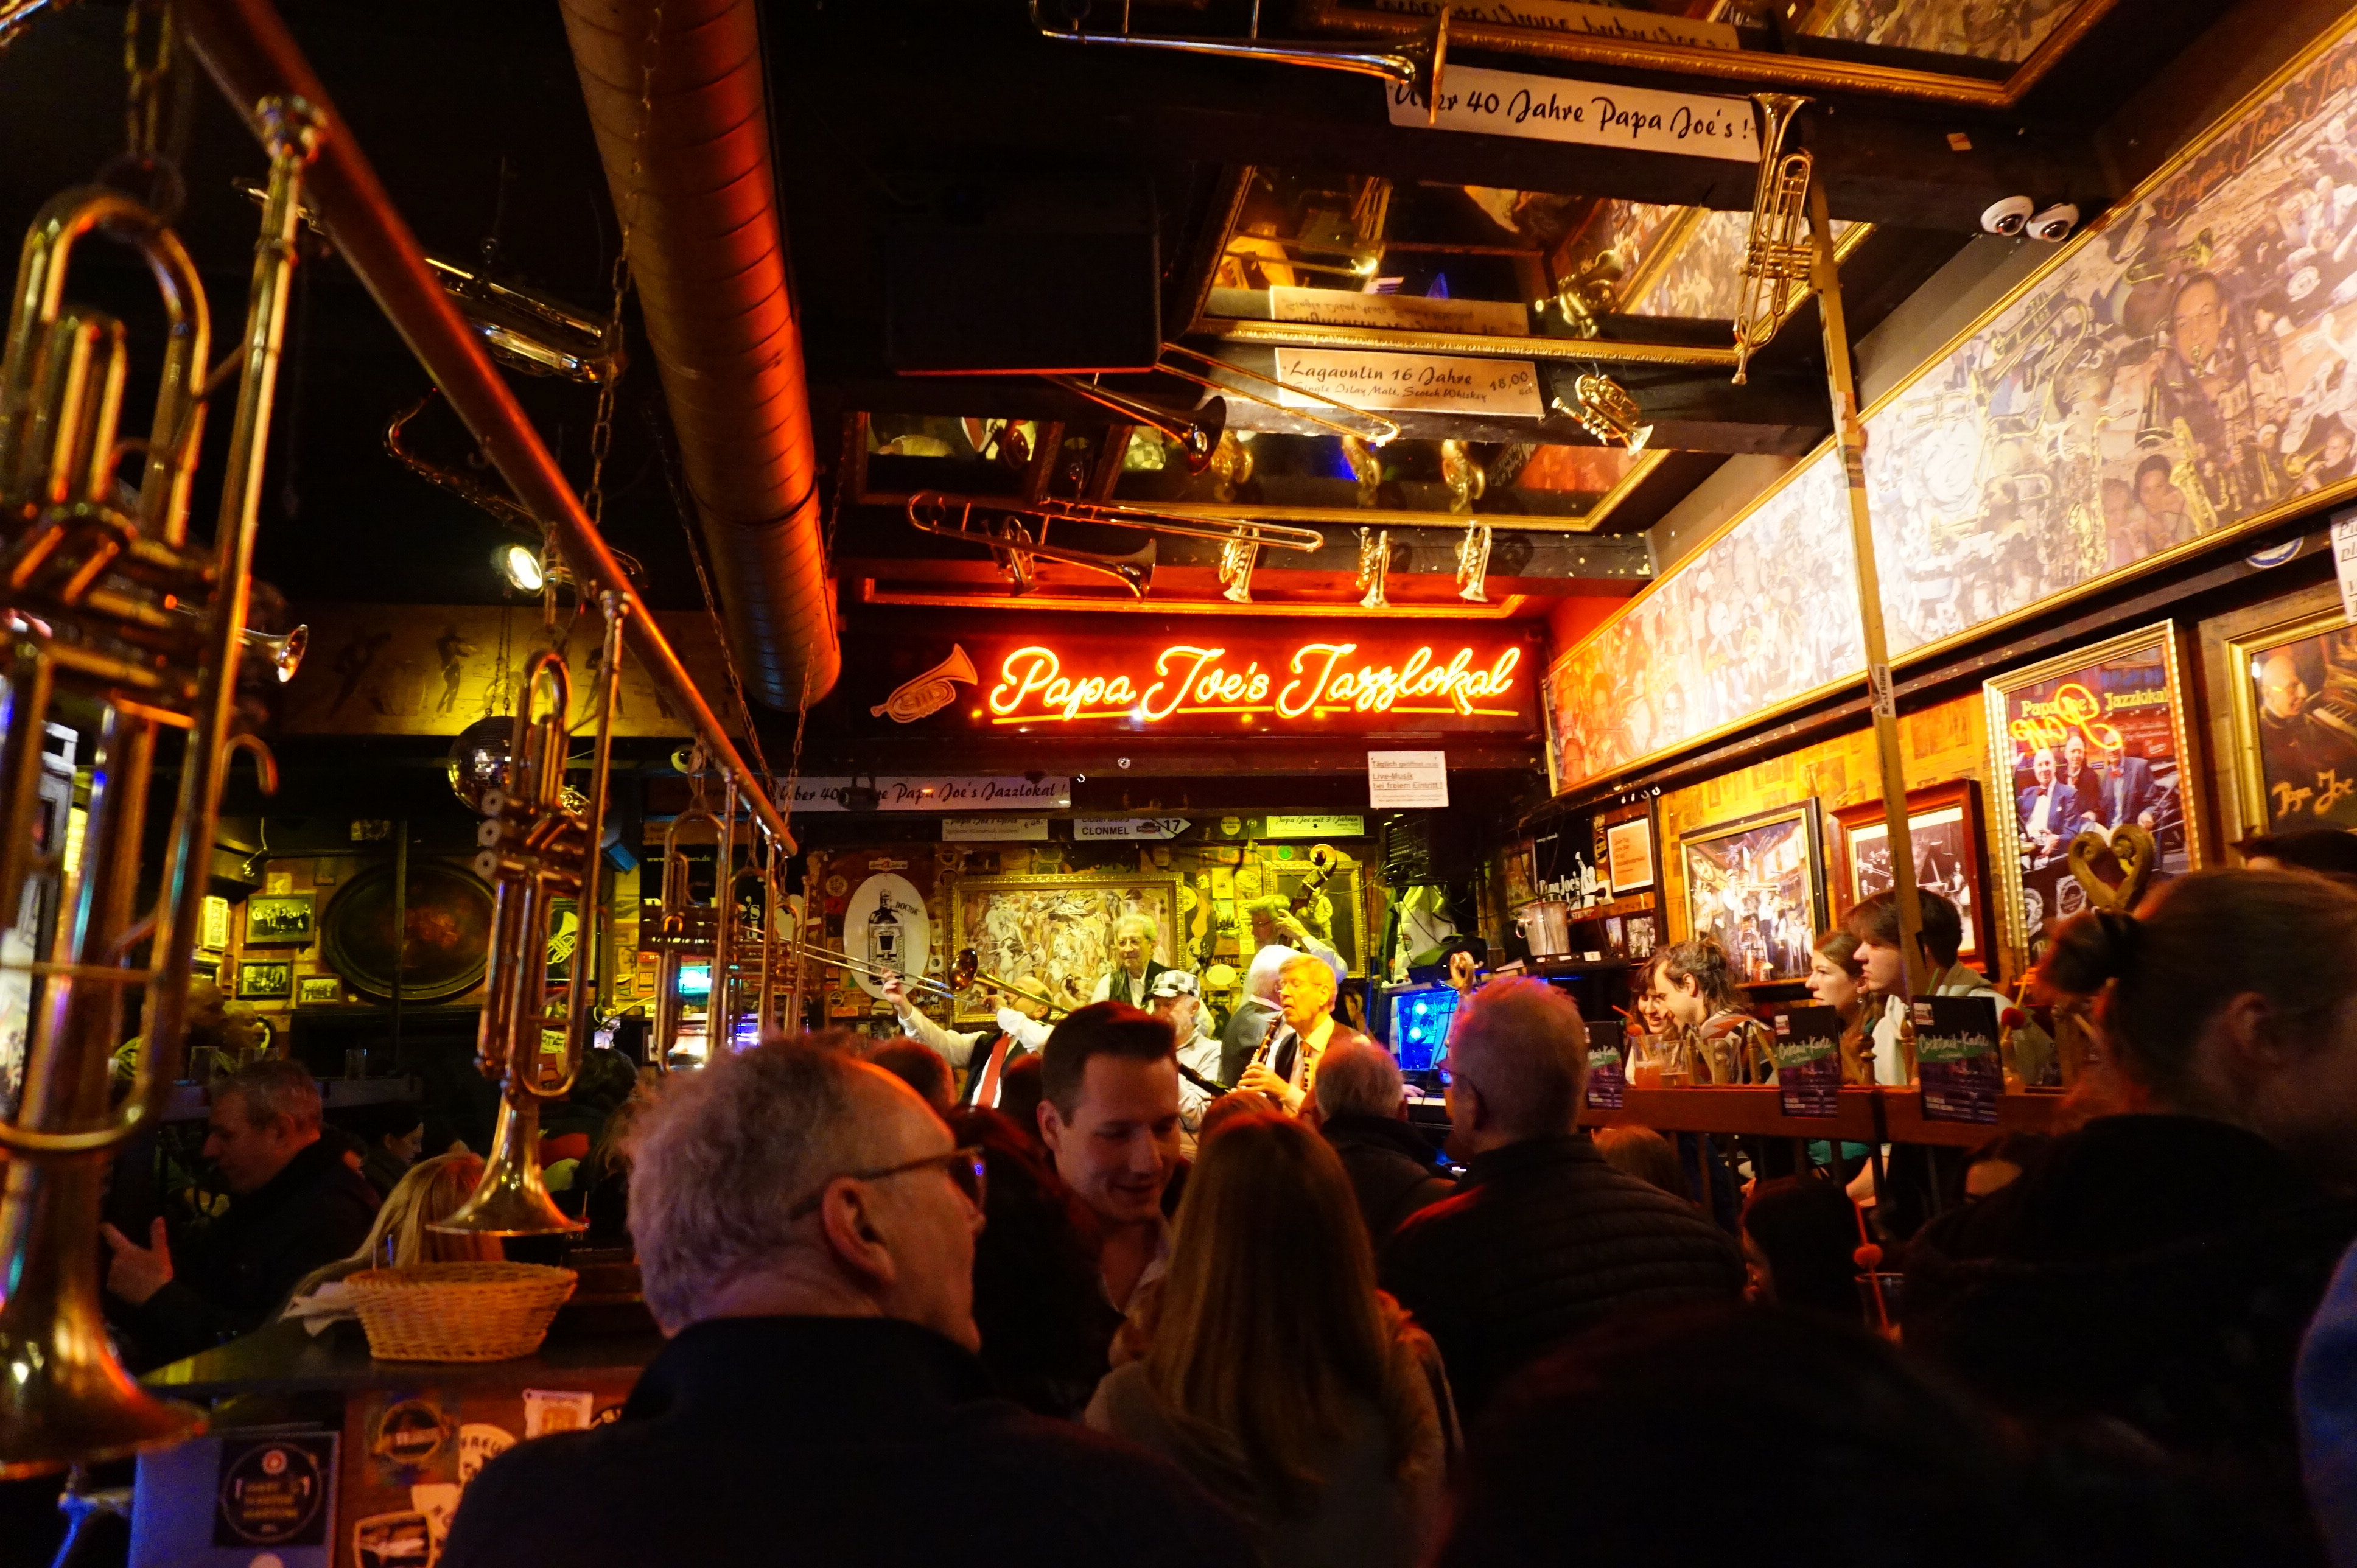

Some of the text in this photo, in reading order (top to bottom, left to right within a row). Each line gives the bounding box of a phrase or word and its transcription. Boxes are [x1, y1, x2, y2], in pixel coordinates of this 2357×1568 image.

[1466, 90, 1499, 114] 40
[1507, 89, 1584, 123] Jahre
[1591, 96, 1662, 138] Papa
[1670, 108, 1733, 139] Joe's
[2076, 349, 2106, 369] 25
[1290, 360, 1529, 391] Lagavulin 16 Jahre 18,00
[1402, 387, 1440, 397] Scotch
[989, 643, 1521, 722] Papa Joe's Jazzlokal
[2020, 700, 2059, 719] Papa
[2104, 687, 2170, 712] Jazzlokal
[892, 783, 934, 804] Papa
[938, 782, 978, 802] Joe's
[981, 782, 1056, 802] Jazzlokal
[2271, 768, 2355, 817] Papa Joe
[1082, 827, 1130, 835] CLONMEL
[1163, 819, 1181, 831] 17
[895, 901, 919, 915] DOCTOR
